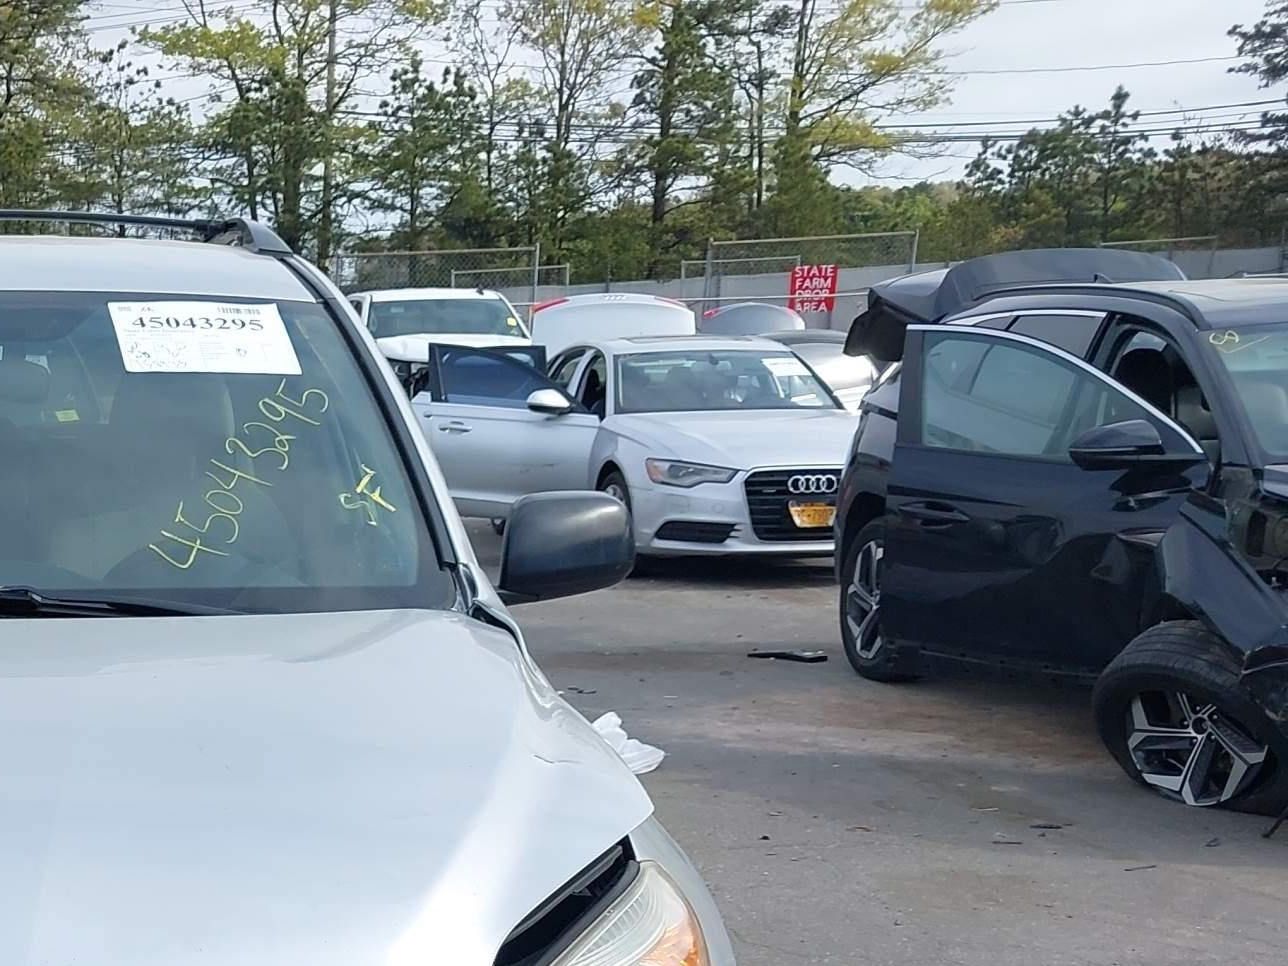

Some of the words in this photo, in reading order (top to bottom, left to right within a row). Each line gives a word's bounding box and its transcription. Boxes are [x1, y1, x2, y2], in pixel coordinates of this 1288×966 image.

[794, 265, 835, 277] STATE
[795, 277, 832, 290] FARM
[795, 301, 828, 313] AREA
[132, 316, 265, 332] 45043295
[148, 377, 329, 569] 45043295
